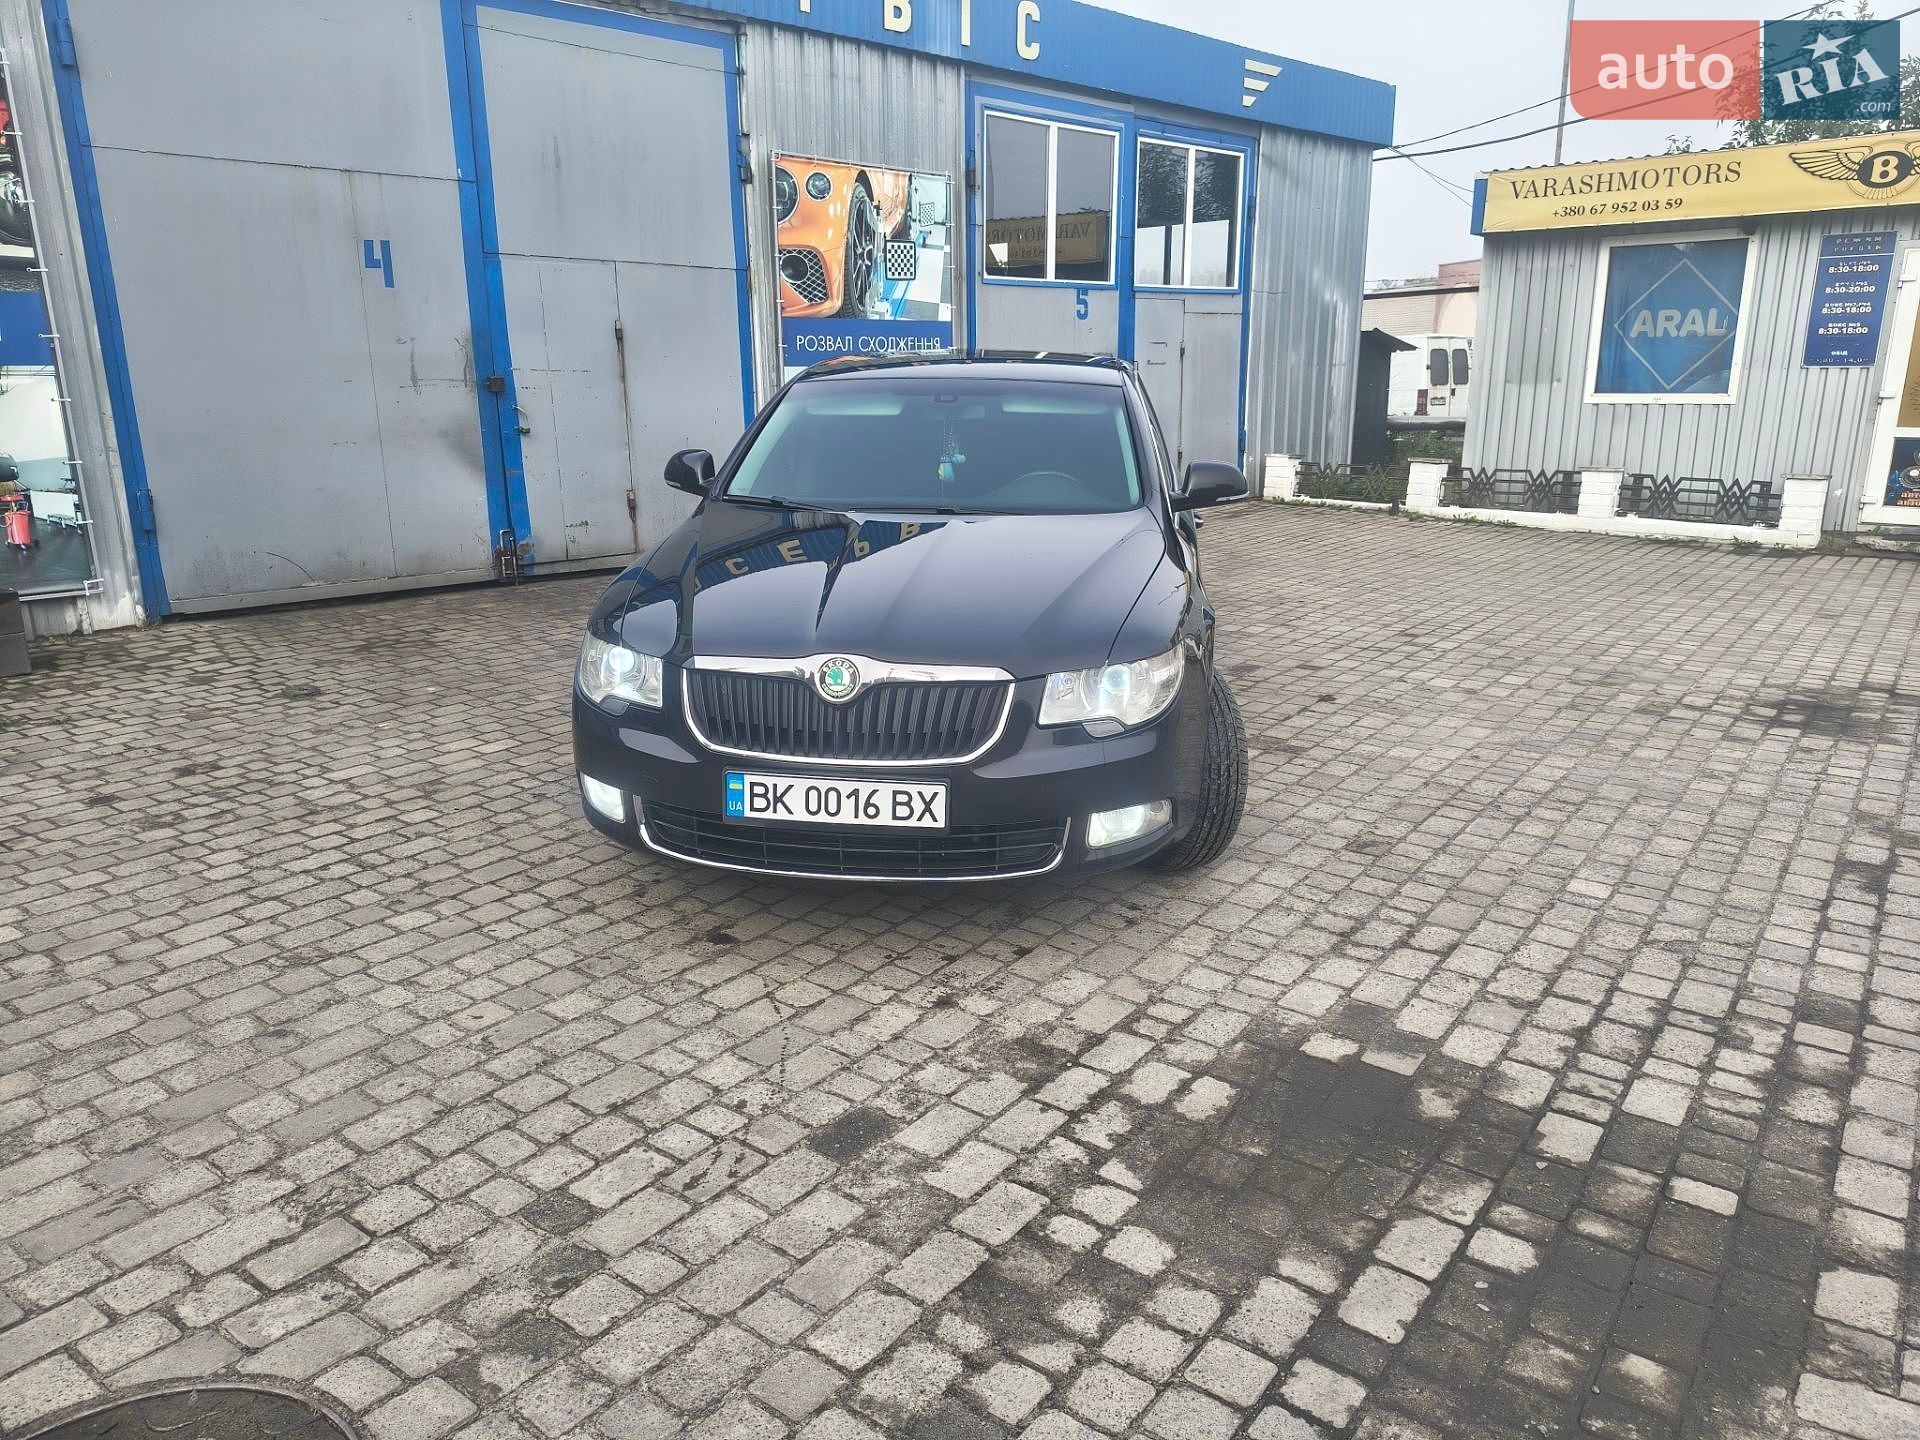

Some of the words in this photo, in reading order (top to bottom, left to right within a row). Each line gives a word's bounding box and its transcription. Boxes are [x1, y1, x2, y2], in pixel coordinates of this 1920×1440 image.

[1510, 160, 1742, 200] VARASHMOTORS
[1552, 205, 1585, 218] +380
[1590, 203, 1607, 215] 67
[1611, 201, 1637, 213] 952
[1642, 199, 1660, 211] 03
[1664, 198, 1683, 210] 59
[363, 239, 395, 289] 4
[1828, 264, 1879, 273] 8:30-18:00
[1076, 288, 1089, 320] 5
[1630, 307, 1727, 338] ARAL
[796, 335, 853, 351] РОЗВАЛ
[858, 336, 941, 351] СХОДЖЕННЯ
[729, 801, 743, 811] UA
[749, 782, 795, 815] BK
[805, 785, 881, 820] 0016
[891, 790, 940, 823] BX
